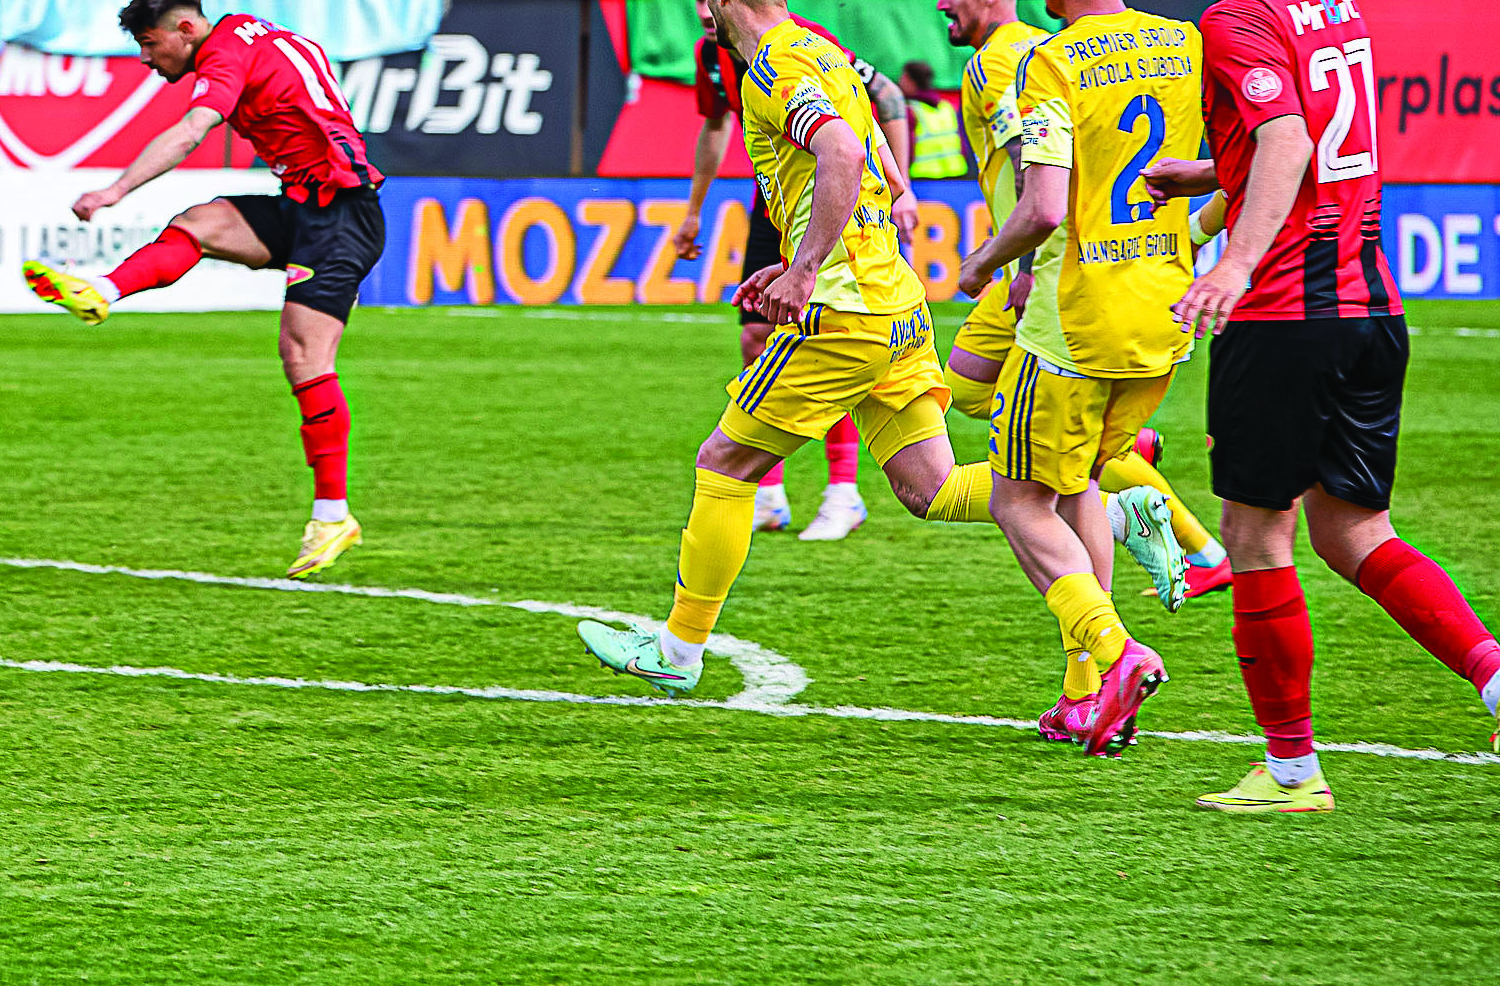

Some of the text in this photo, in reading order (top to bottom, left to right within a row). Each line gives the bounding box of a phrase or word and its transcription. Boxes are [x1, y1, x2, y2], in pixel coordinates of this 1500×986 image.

[340, 33, 554, 136] MrBit
[1064, 32, 1139, 65] PREMIER
[1139, 27, 1187, 48] GROUP
[1079, 61, 1135, 91] AVICOLA
[1111, 94, 1166, 225] 2
[1397, 213, 1484, 294] DE
